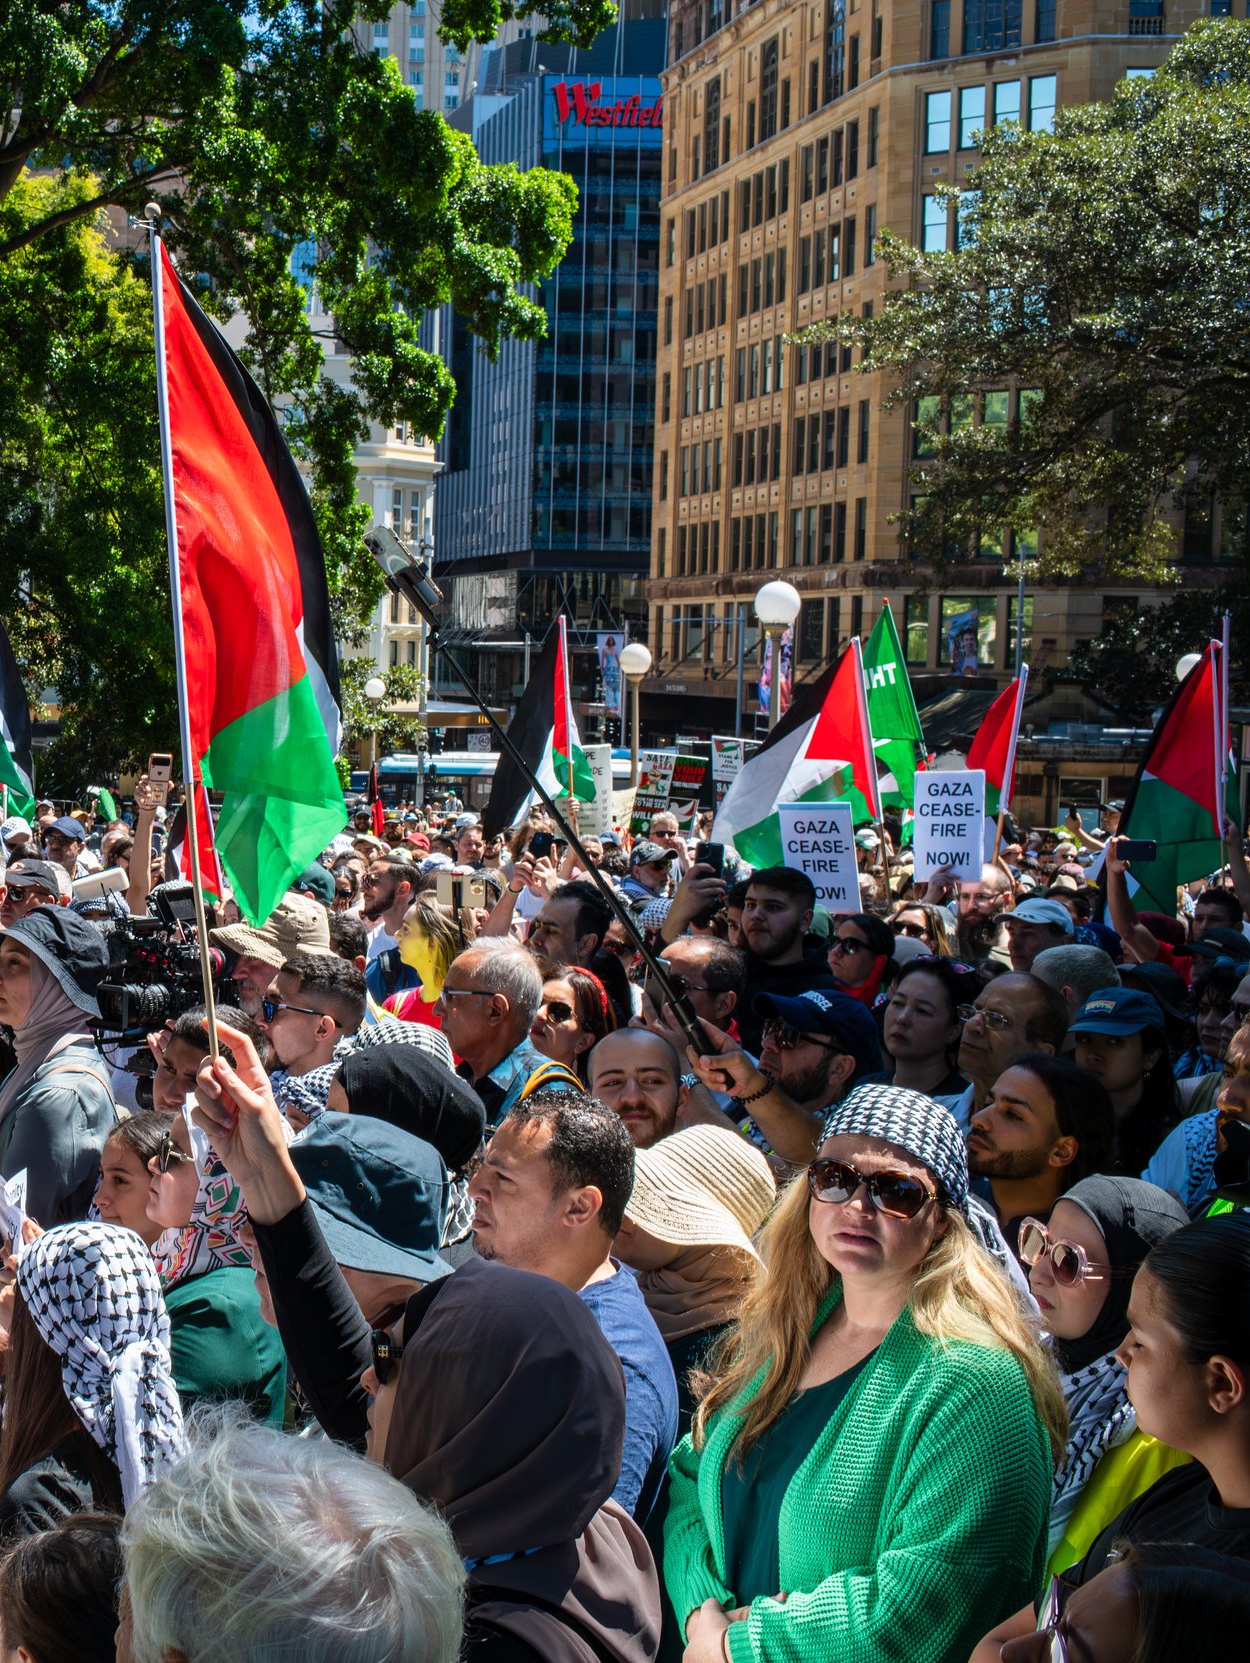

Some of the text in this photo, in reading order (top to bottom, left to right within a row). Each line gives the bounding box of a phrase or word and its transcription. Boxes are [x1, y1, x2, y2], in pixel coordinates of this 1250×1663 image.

[551, 82, 663, 126] Westfiel
[675, 765, 706, 776] YOUR
[673, 773, 704, 784] VOICE
[927, 783, 973, 796] GAZA
[919, 803, 981, 817] CEASE-
[793, 821, 840, 834] GAZA
[930, 823, 967, 837] FIRE
[787, 840, 850, 853] CEASE-
[926, 852, 970, 866] NOW!
[802, 860, 840, 873] FIRE
[815, 886, 846, 900] OW!
